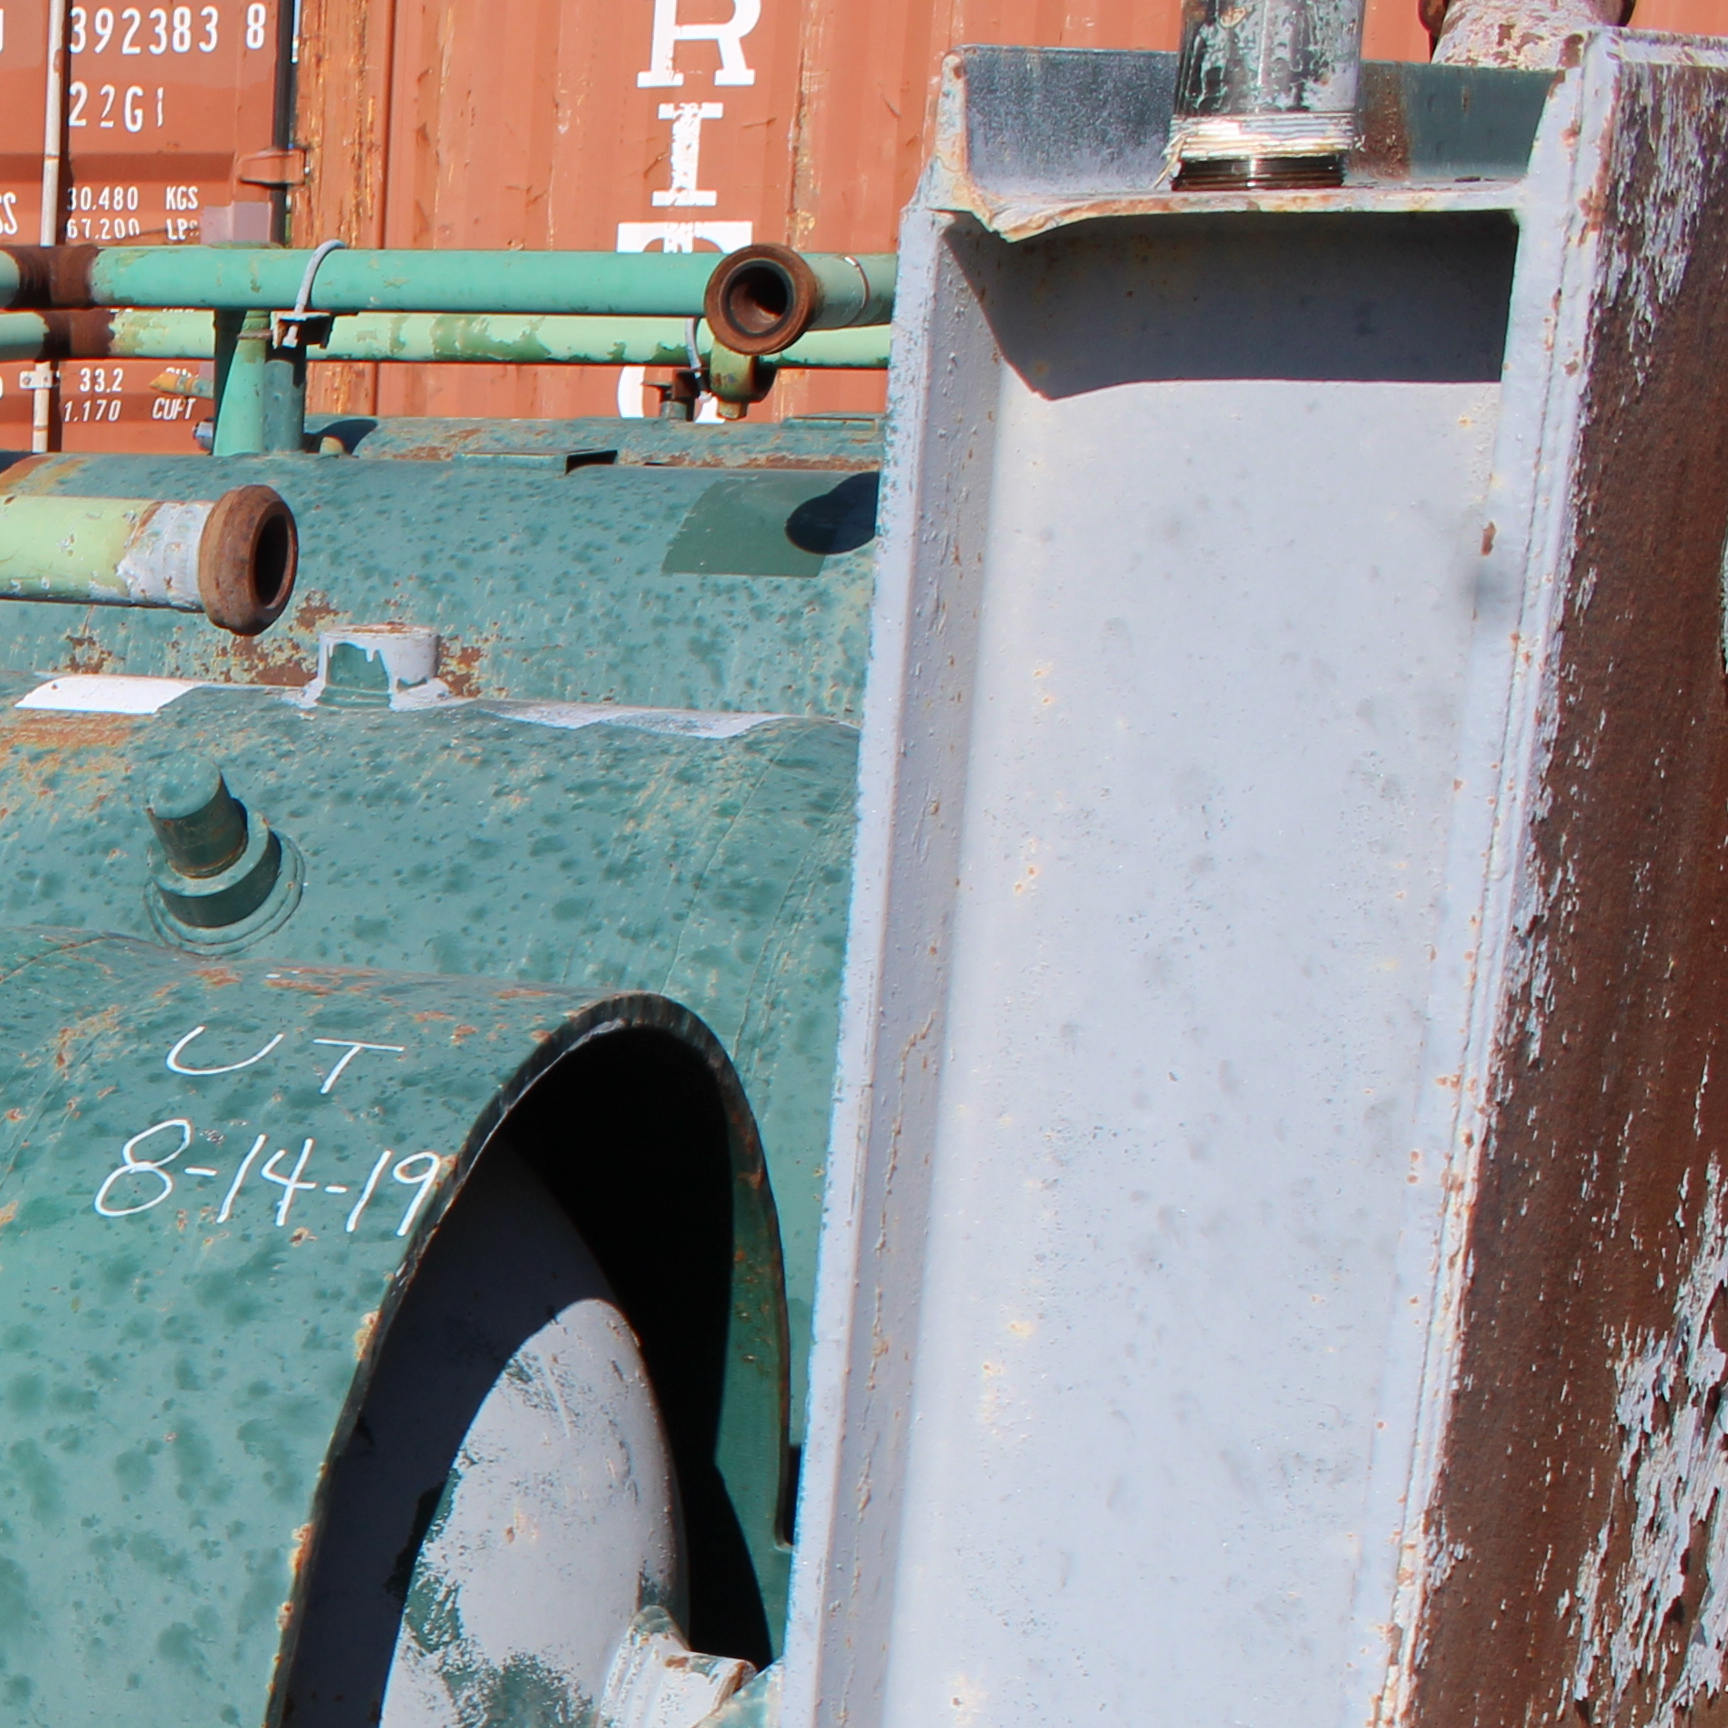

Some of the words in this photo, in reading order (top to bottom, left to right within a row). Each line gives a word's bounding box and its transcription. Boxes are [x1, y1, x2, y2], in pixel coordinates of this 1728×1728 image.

[69, 5, 220, 55] 392383
[245, 2, 267, 50] 8
[165, 185, 200, 210] KGS
[79, 367, 124, 394] 33.2
[94, 1117, 443, 1239] 8-14-19
